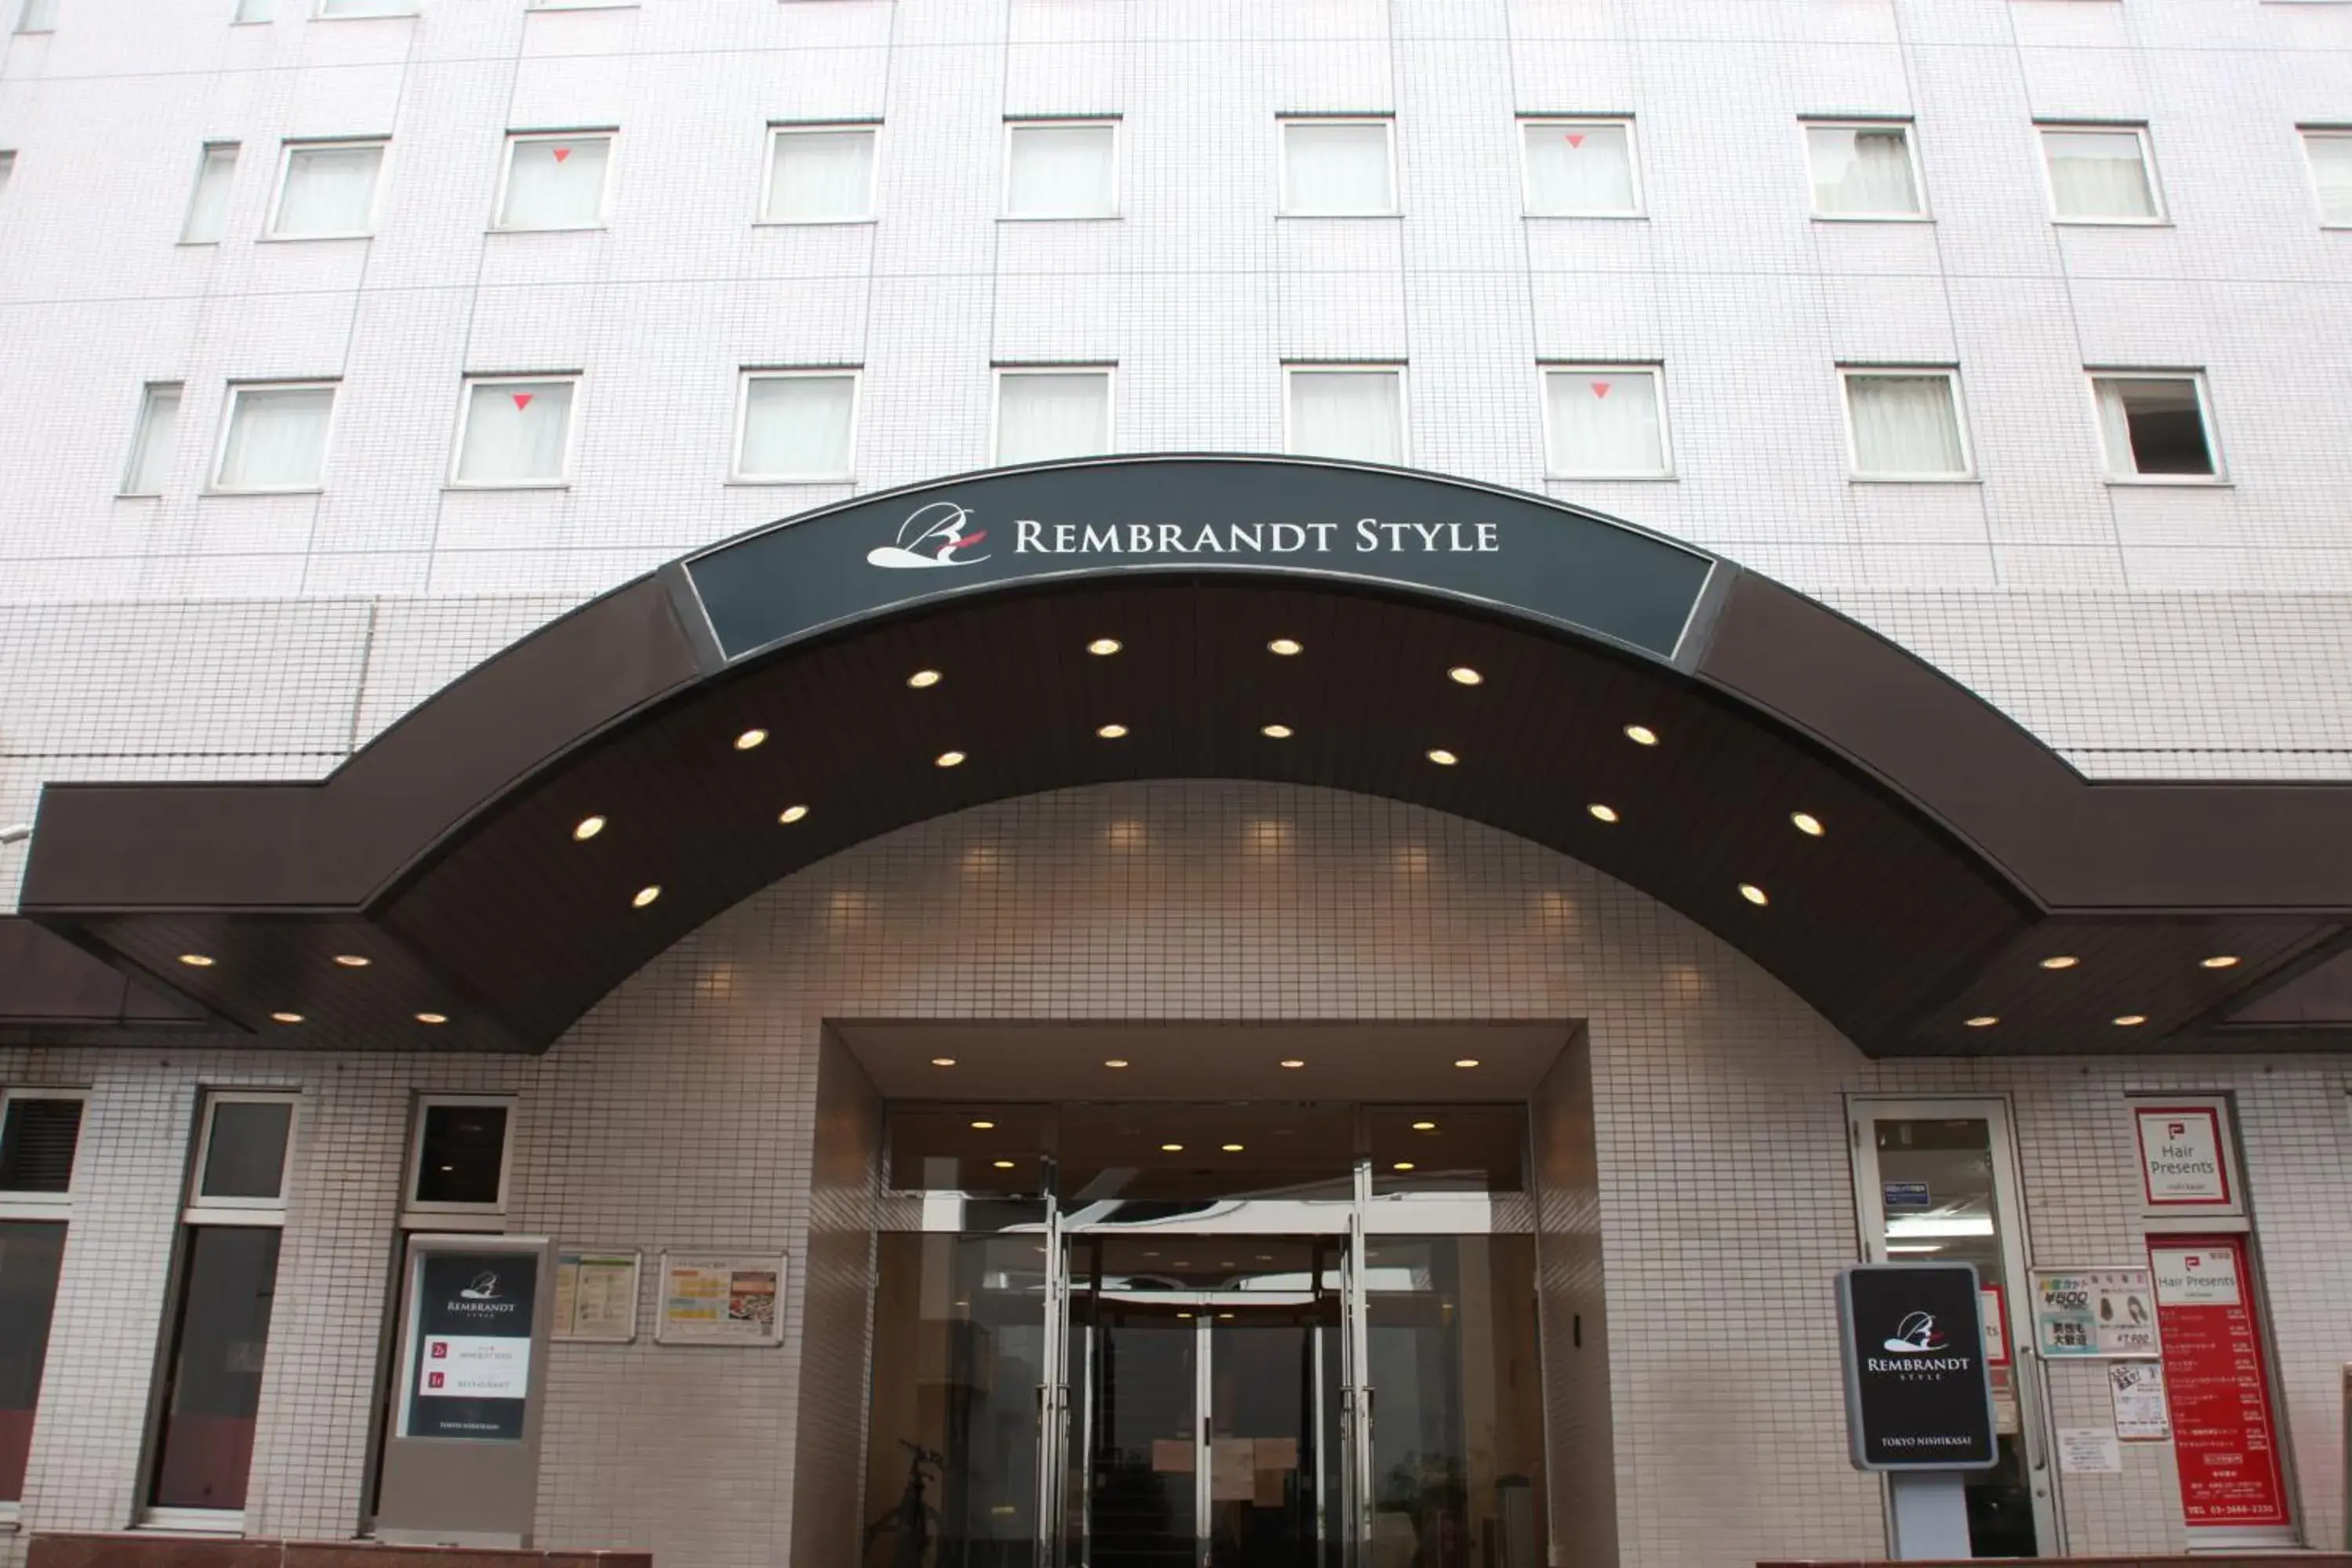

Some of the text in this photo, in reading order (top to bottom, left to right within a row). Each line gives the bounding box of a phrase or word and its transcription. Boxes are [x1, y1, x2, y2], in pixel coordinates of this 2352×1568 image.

[1014, 518, 1499, 553] REMBRANDT STYLE
[2161, 1145, 2195, 1158] Hair
[2151, 1161, 2215, 1174] Presents
[2186, 1276, 2235, 1287] Presents
[448, 1301, 516, 1312] REMBRANDT
[1867, 1358, 1970, 1371] REMBRANDT
[1882, 1436, 1973, 1447] TOKYO NISHIKASAI
